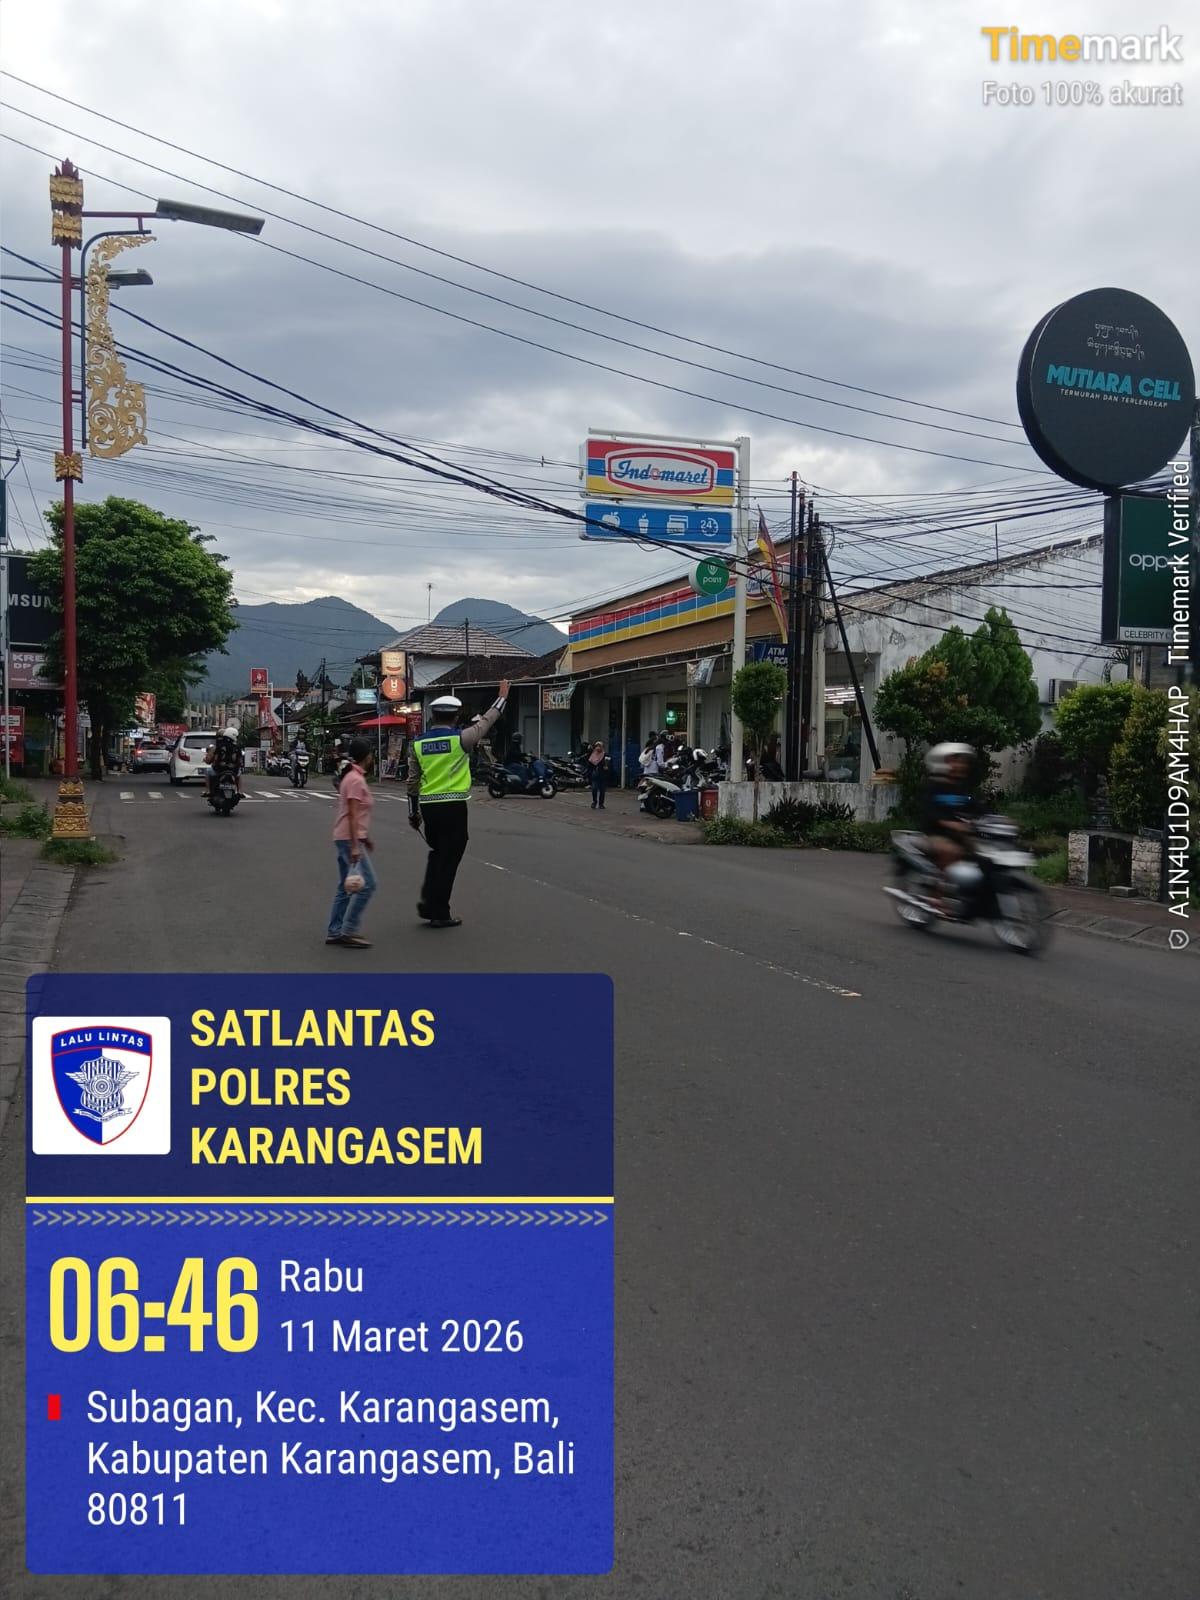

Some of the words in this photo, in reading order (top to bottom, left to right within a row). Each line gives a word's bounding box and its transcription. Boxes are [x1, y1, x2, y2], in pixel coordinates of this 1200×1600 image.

[1047, 364, 1132, 395] MUTIARA
[1138, 378, 1181, 401] CELL
[1060, 388, 1100, 400] TERMURAH
[1103, 393, 1118, 402] DAN
[1121, 396, 1168, 408] TERLENGKAP
[614, 460, 708, 484] Indomaret
[1129, 554, 1176, 572] opp
[8, 594, 52, 608] MSUN
[1124, 630, 1165, 639] CELEBRITY
[12, 654, 47, 662] KRE
[768, 648, 786, 656] ATM
[422, 742, 449, 752] POLISI
